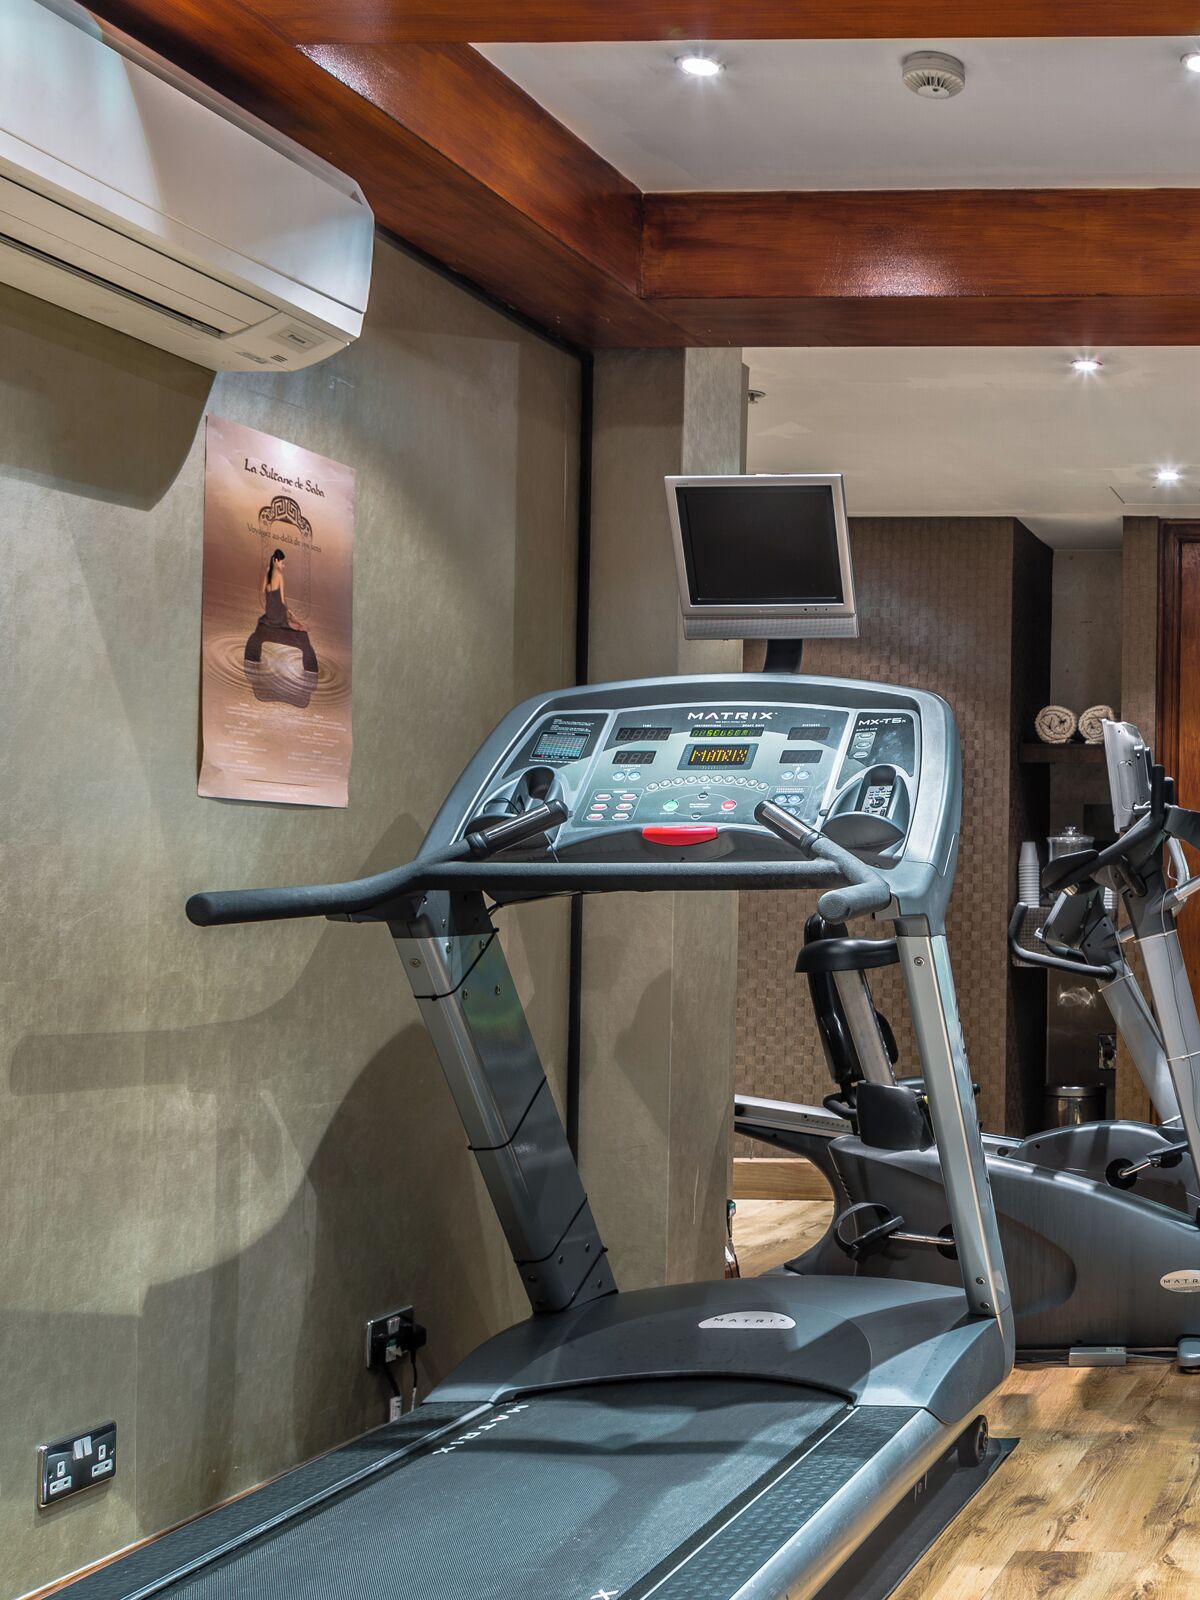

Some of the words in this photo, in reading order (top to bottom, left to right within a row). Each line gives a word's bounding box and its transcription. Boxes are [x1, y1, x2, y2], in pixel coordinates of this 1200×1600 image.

[244, 458, 257, 474] La
[260, 463, 293, 486] Sultane
[294, 477, 304, 489] de
[305, 479, 326, 497] Saba
[687, 712, 774, 720] MATRIX
[690, 749, 748, 762] MATRIX
[432, 1404, 529, 1455] MATRIX
